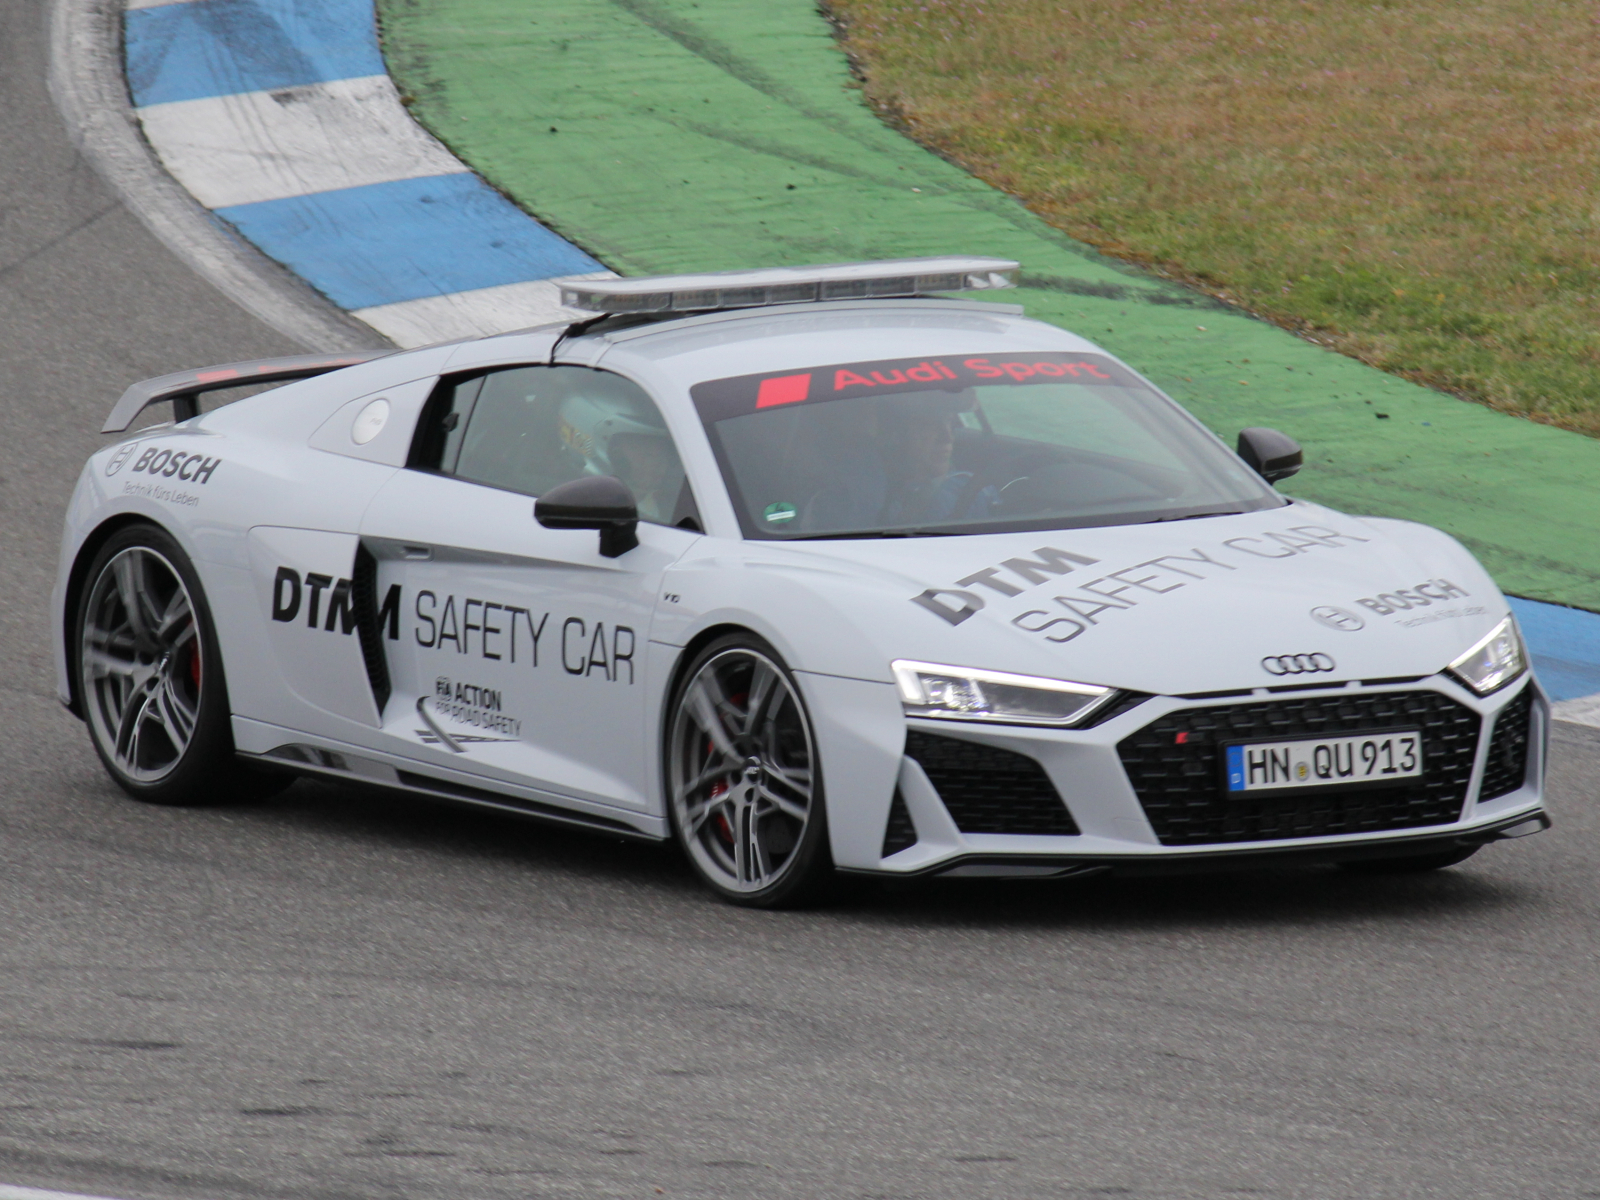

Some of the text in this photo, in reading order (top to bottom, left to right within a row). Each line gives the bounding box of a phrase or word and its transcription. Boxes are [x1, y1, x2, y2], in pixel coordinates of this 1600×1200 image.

[832, 357, 1111, 390] Audi Sport
[132, 447, 222, 484] BOSCH
[908, 546, 1101, 627] DTM
[1010, 525, 1371, 643] SAFETY CAR
[1354, 579, 1471, 616] BOSCH
[272, 566, 635, 685] DTM SAFETY CAR
[455, 682, 502, 712] ACTION
[482, 712, 522, 737] SAFETY
[1247, 737, 1417, 785] HN QU 913
